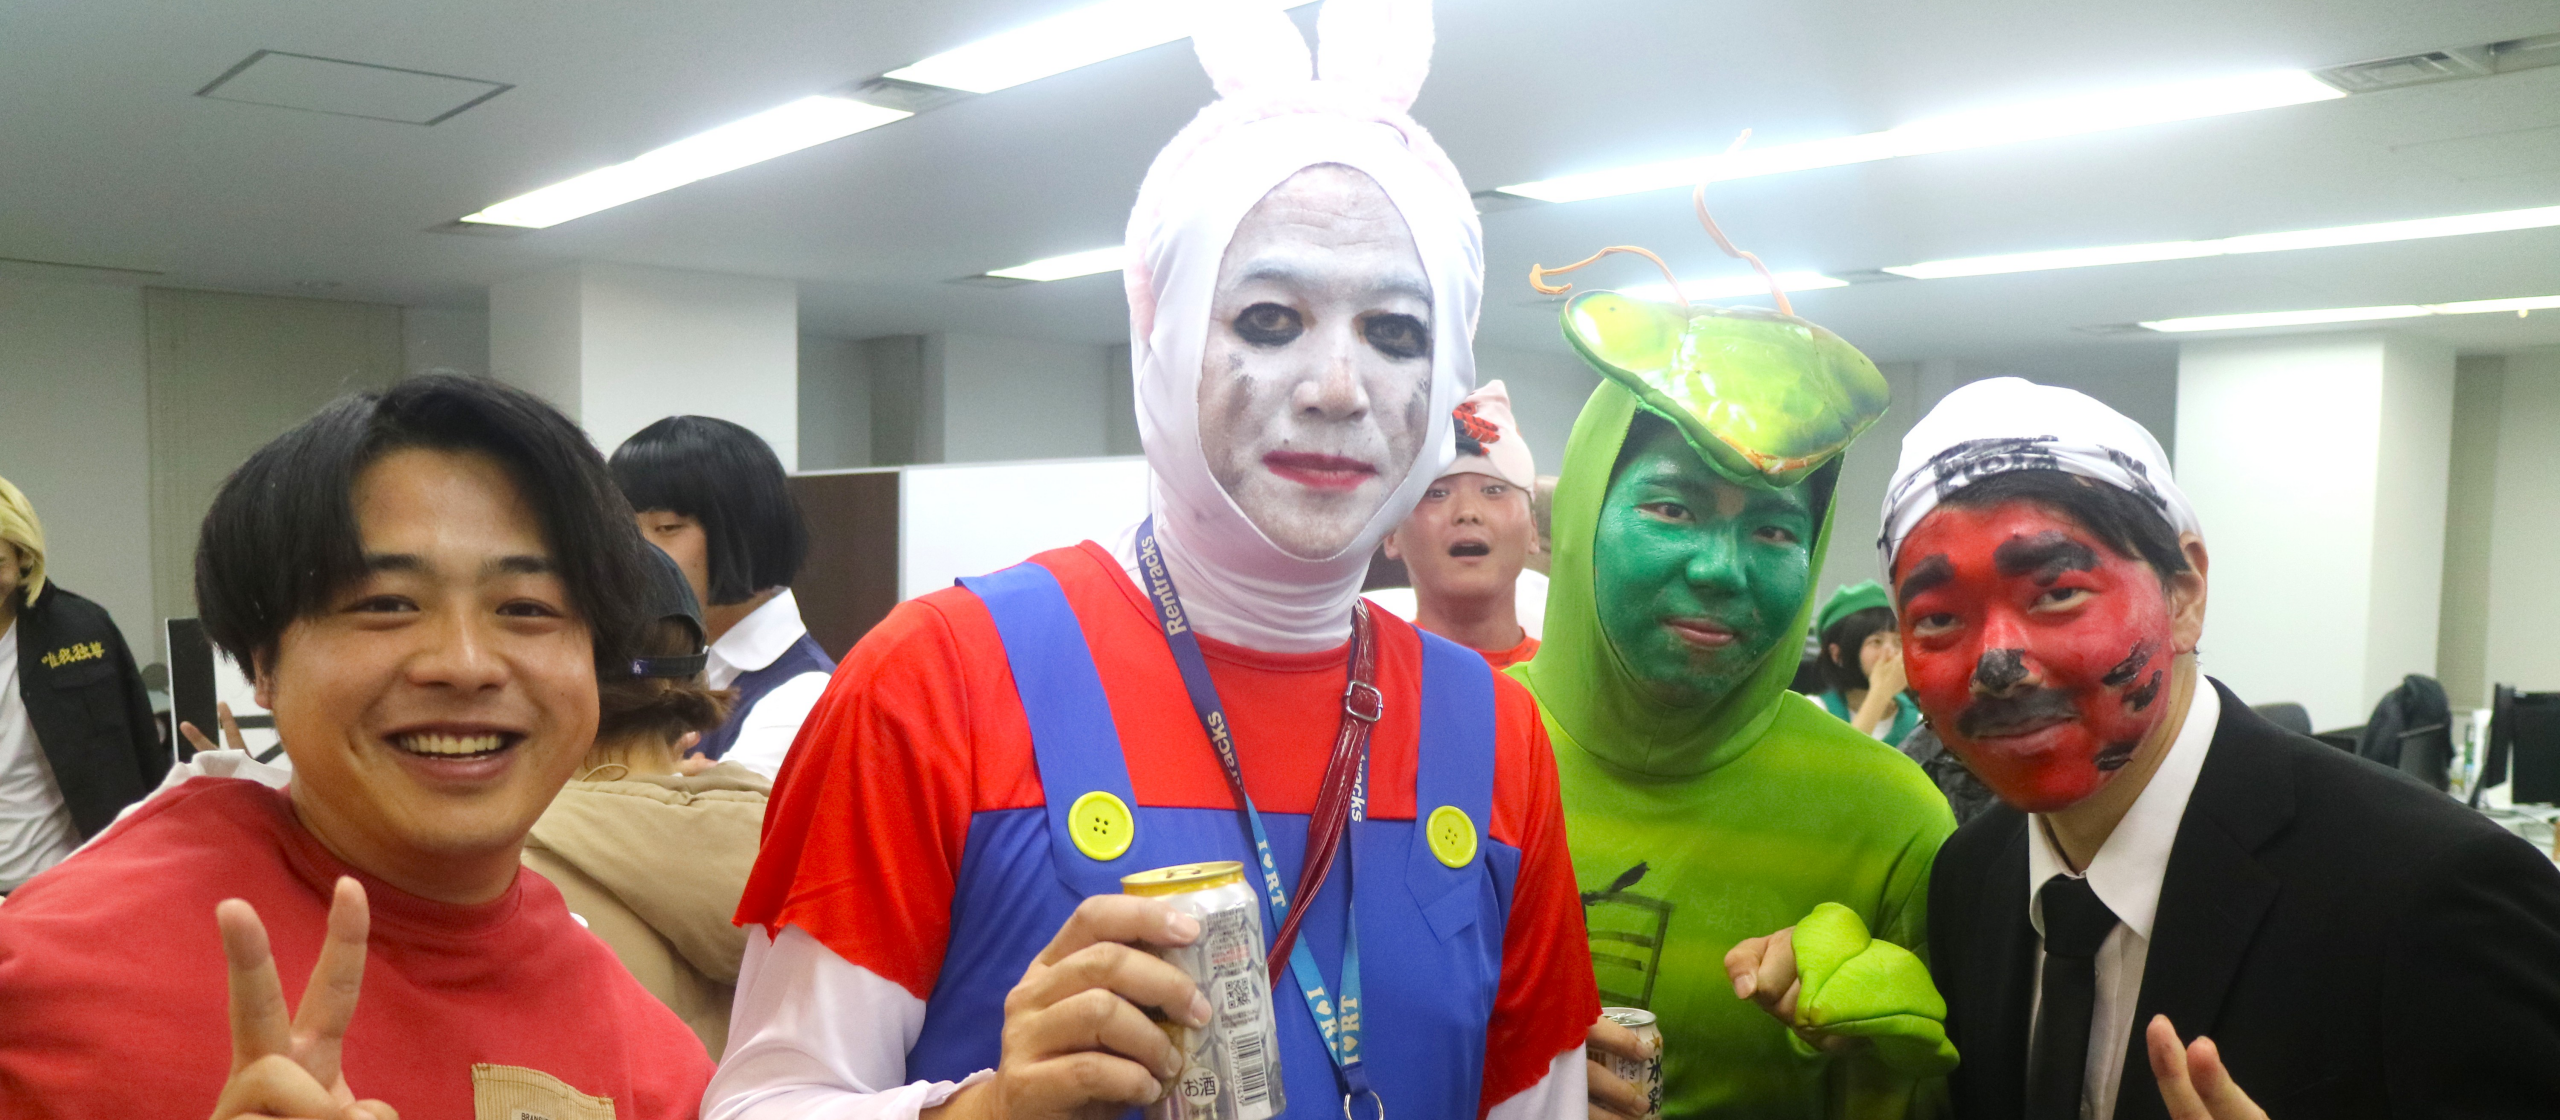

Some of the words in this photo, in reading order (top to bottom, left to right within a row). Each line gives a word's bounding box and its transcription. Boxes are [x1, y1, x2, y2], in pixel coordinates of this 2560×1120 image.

[1140, 535, 1188, 636] Rentracks
[41, 640, 106, 669] 唯我独尊
[1257, 839, 1268, 851] I
[1265, 870, 1287, 907] RT
[1306, 986, 1325, 1000] I
[1340, 994, 1360, 1033] RT
[1183, 1075, 1216, 1097] お酒
